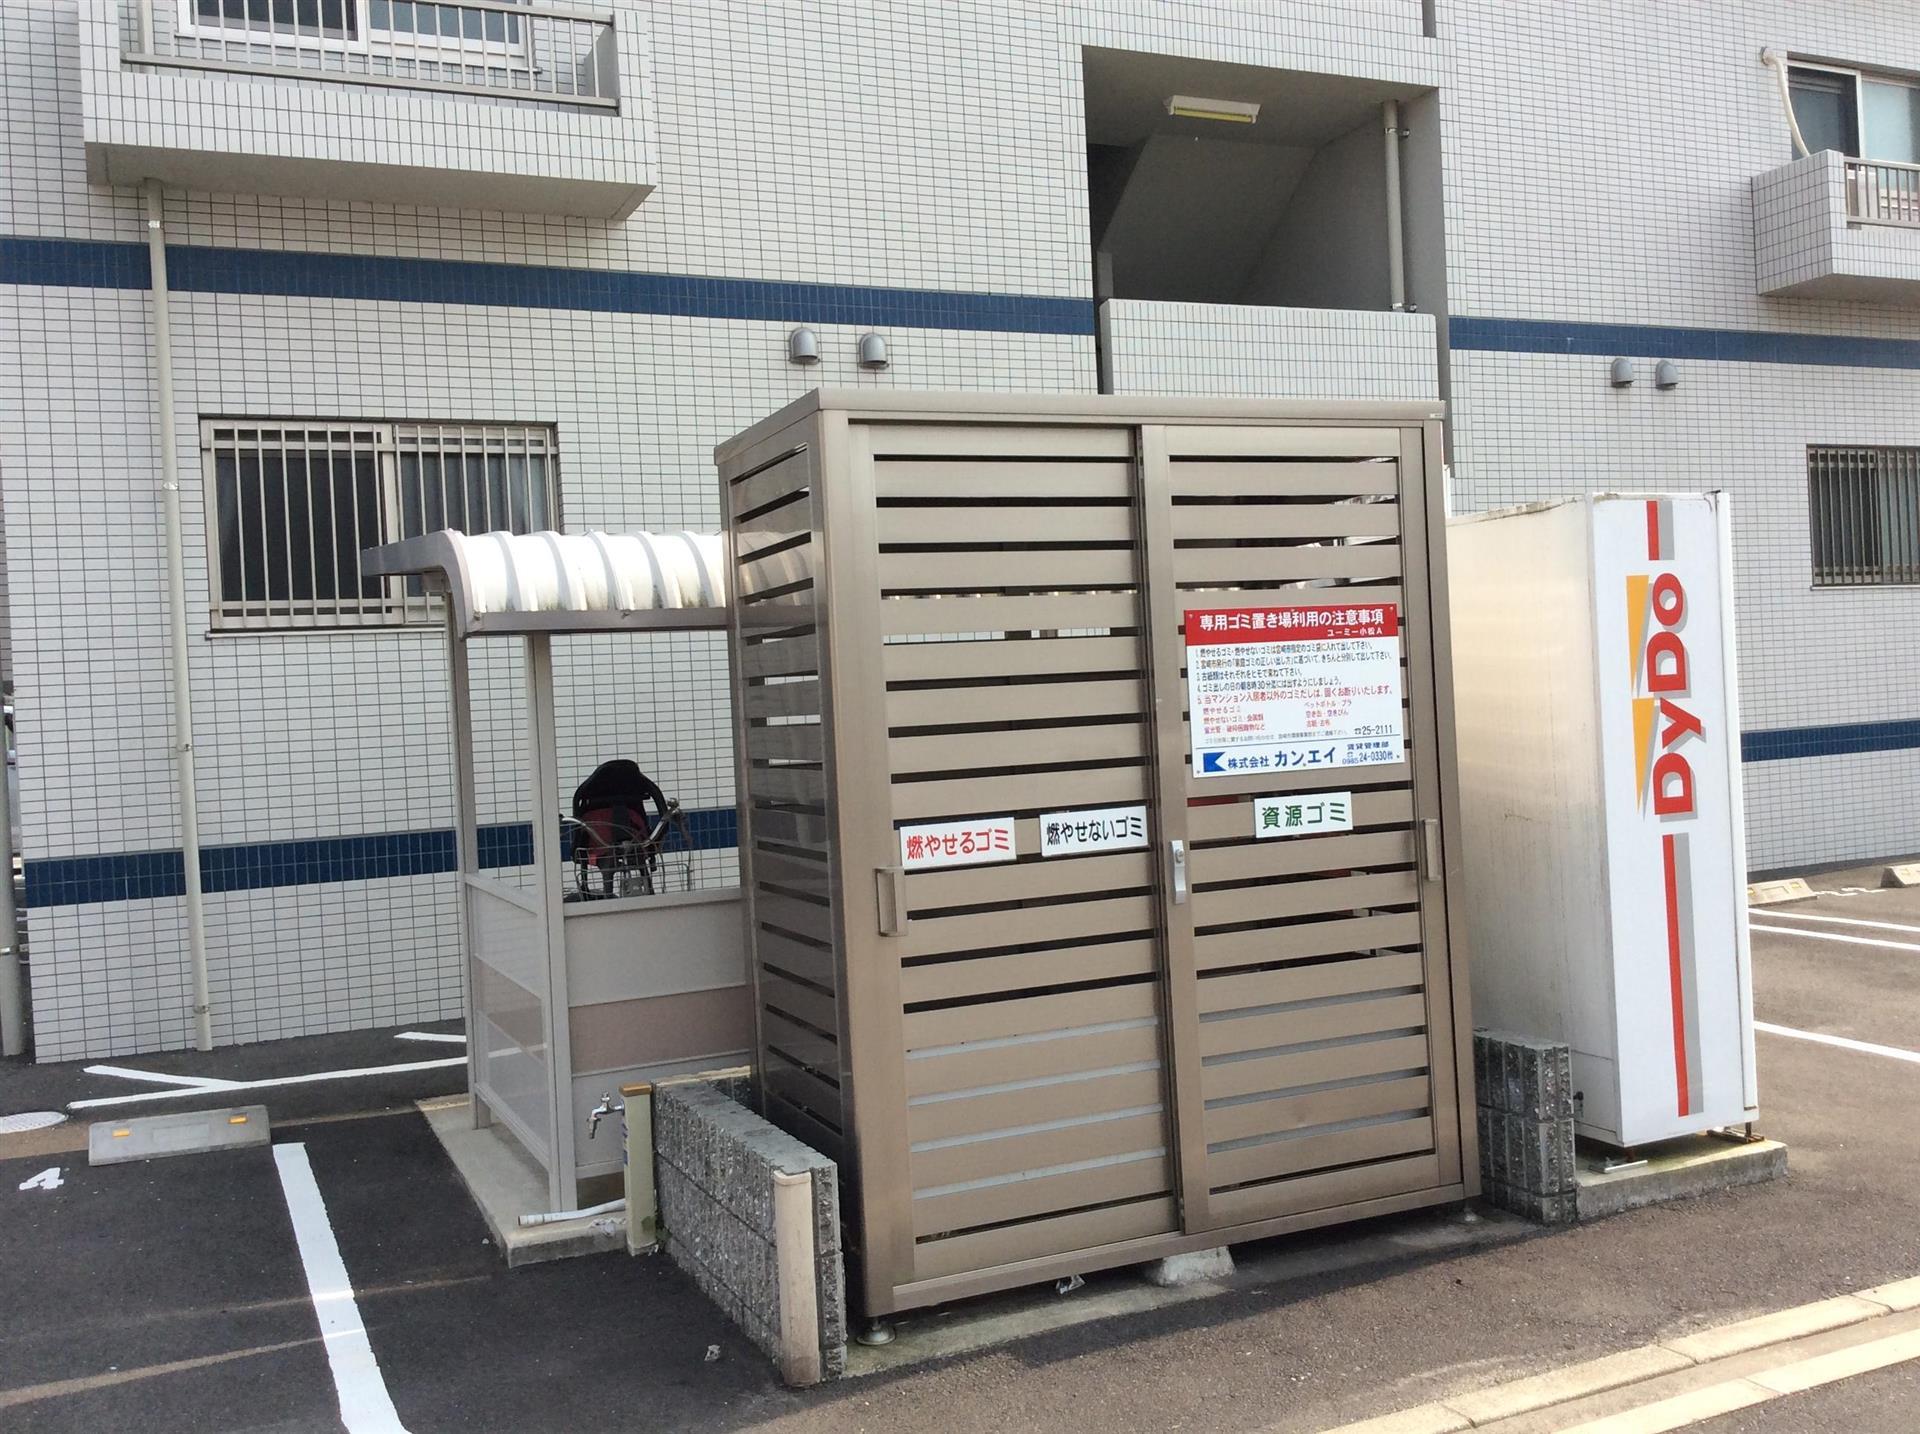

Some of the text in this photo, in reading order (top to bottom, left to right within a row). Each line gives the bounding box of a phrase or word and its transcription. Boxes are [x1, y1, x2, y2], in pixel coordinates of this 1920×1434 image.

[1199, 609, 1384, 631] 専用ゴミ置き場利用の注意事項
[1227, 747, 1337, 769] 株式会社 カンエイ
[1261, 802, 1347, 830] 資源ゴミ
[905, 815, 1143, 861] 燃やせるゴミ 燃やせないゴミ
